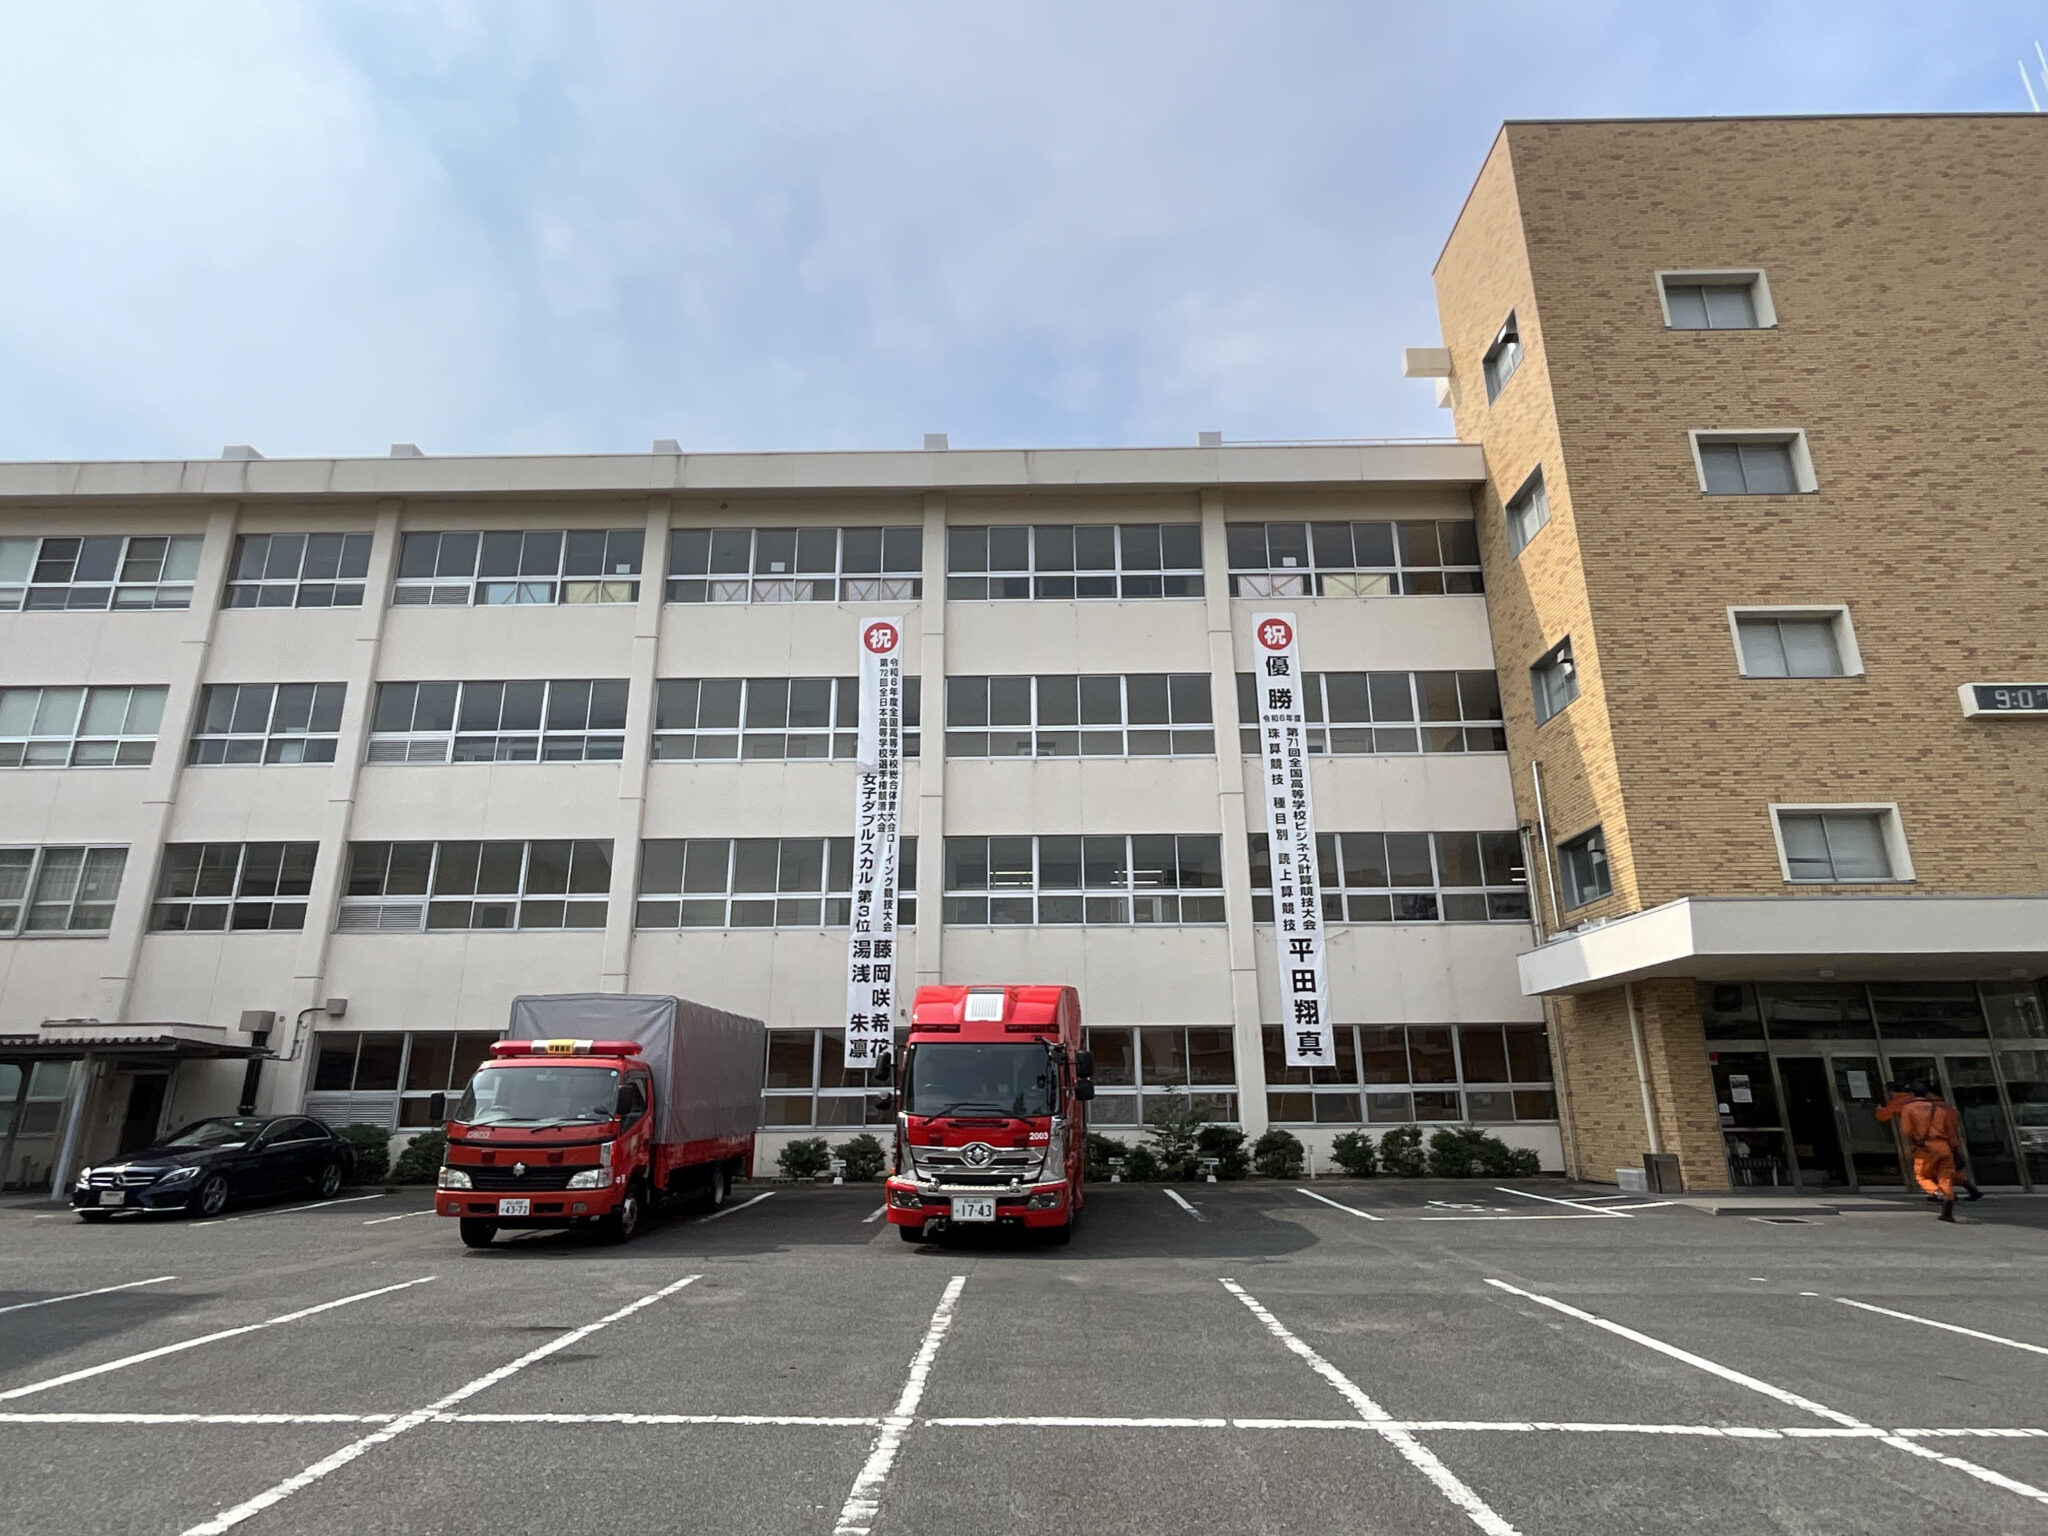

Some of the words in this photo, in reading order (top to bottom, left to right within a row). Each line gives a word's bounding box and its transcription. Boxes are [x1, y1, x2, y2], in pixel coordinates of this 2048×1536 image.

[870, 628, 892, 649] 祝
[1264, 625, 1287, 645] 祝
[1265, 655, 1293, 710] 優勝
[1289, 938, 1323, 1057] 平田翔真
[1029, 1131, 1049, 1140] 2003
[962, 1204, 992, 1217] 17-43
